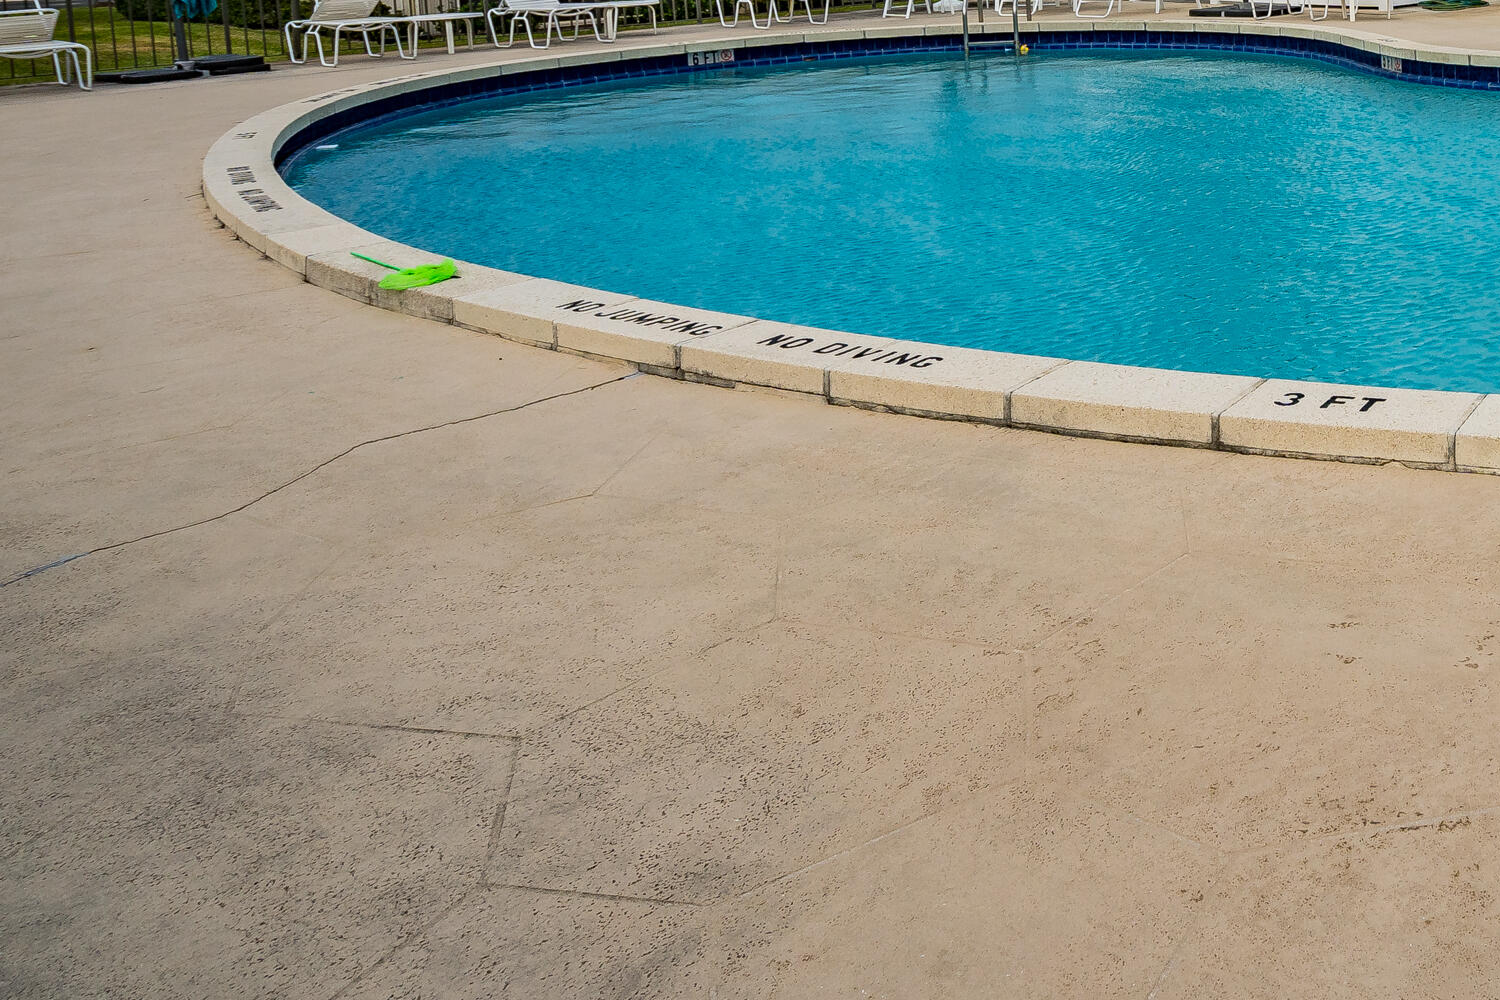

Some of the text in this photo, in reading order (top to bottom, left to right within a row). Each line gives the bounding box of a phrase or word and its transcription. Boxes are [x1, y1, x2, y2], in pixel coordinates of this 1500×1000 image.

[692, 53, 699, 65] 6
[555, 299, 724, 337] NO JUMPING
[756, 334, 945, 368] NO DIVING
[1273, 392, 1388, 412] 3 FT
